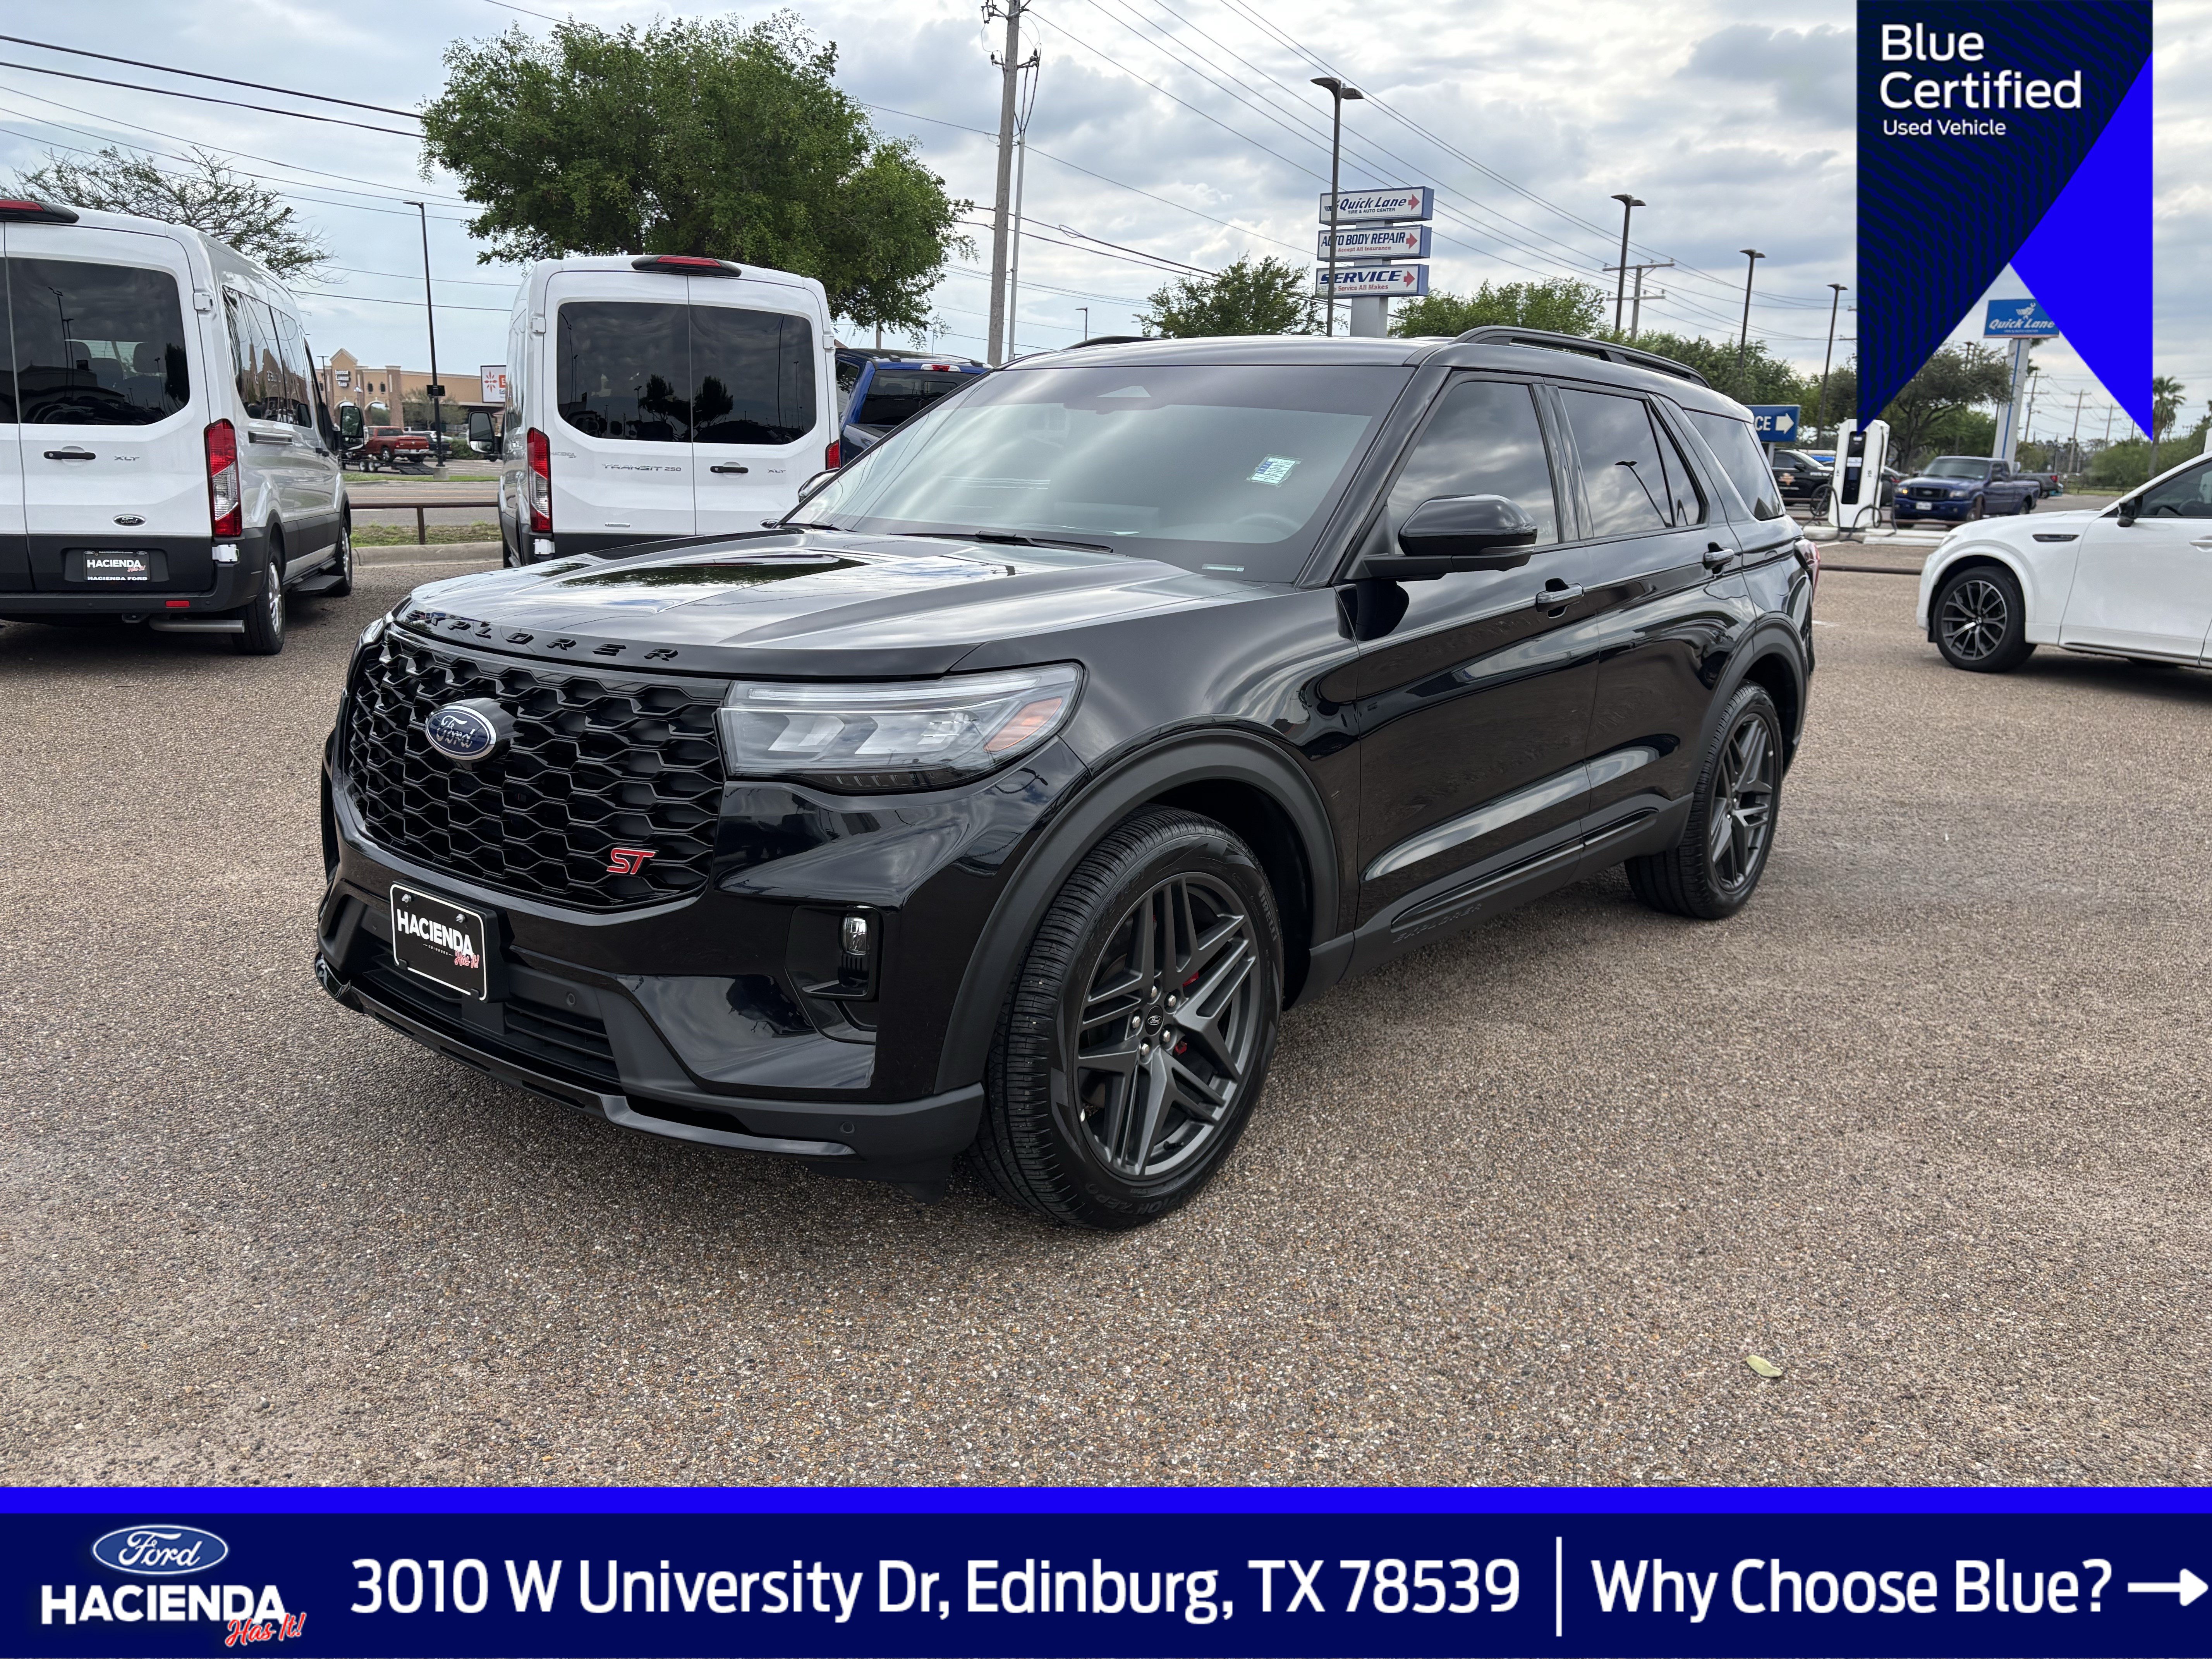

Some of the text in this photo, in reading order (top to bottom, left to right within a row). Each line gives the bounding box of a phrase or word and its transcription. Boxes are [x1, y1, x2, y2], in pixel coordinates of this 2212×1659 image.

[1340, 197, 1407, 210] Quick Lane
[1346, 234, 1370, 245] BODY
[1371, 232, 1405, 244] REPAIR
[1319, 271, 1402, 284] SERVICE
[1989, 318, 2054, 330] Quick Lane
[87, 559, 141, 568] HACIENDA
[406, 610, 679, 661] EXPLORER
[436, 715, 476, 748] Ford
[606, 848, 656, 875] ST
[397, 909, 474, 959] HACIENDA
